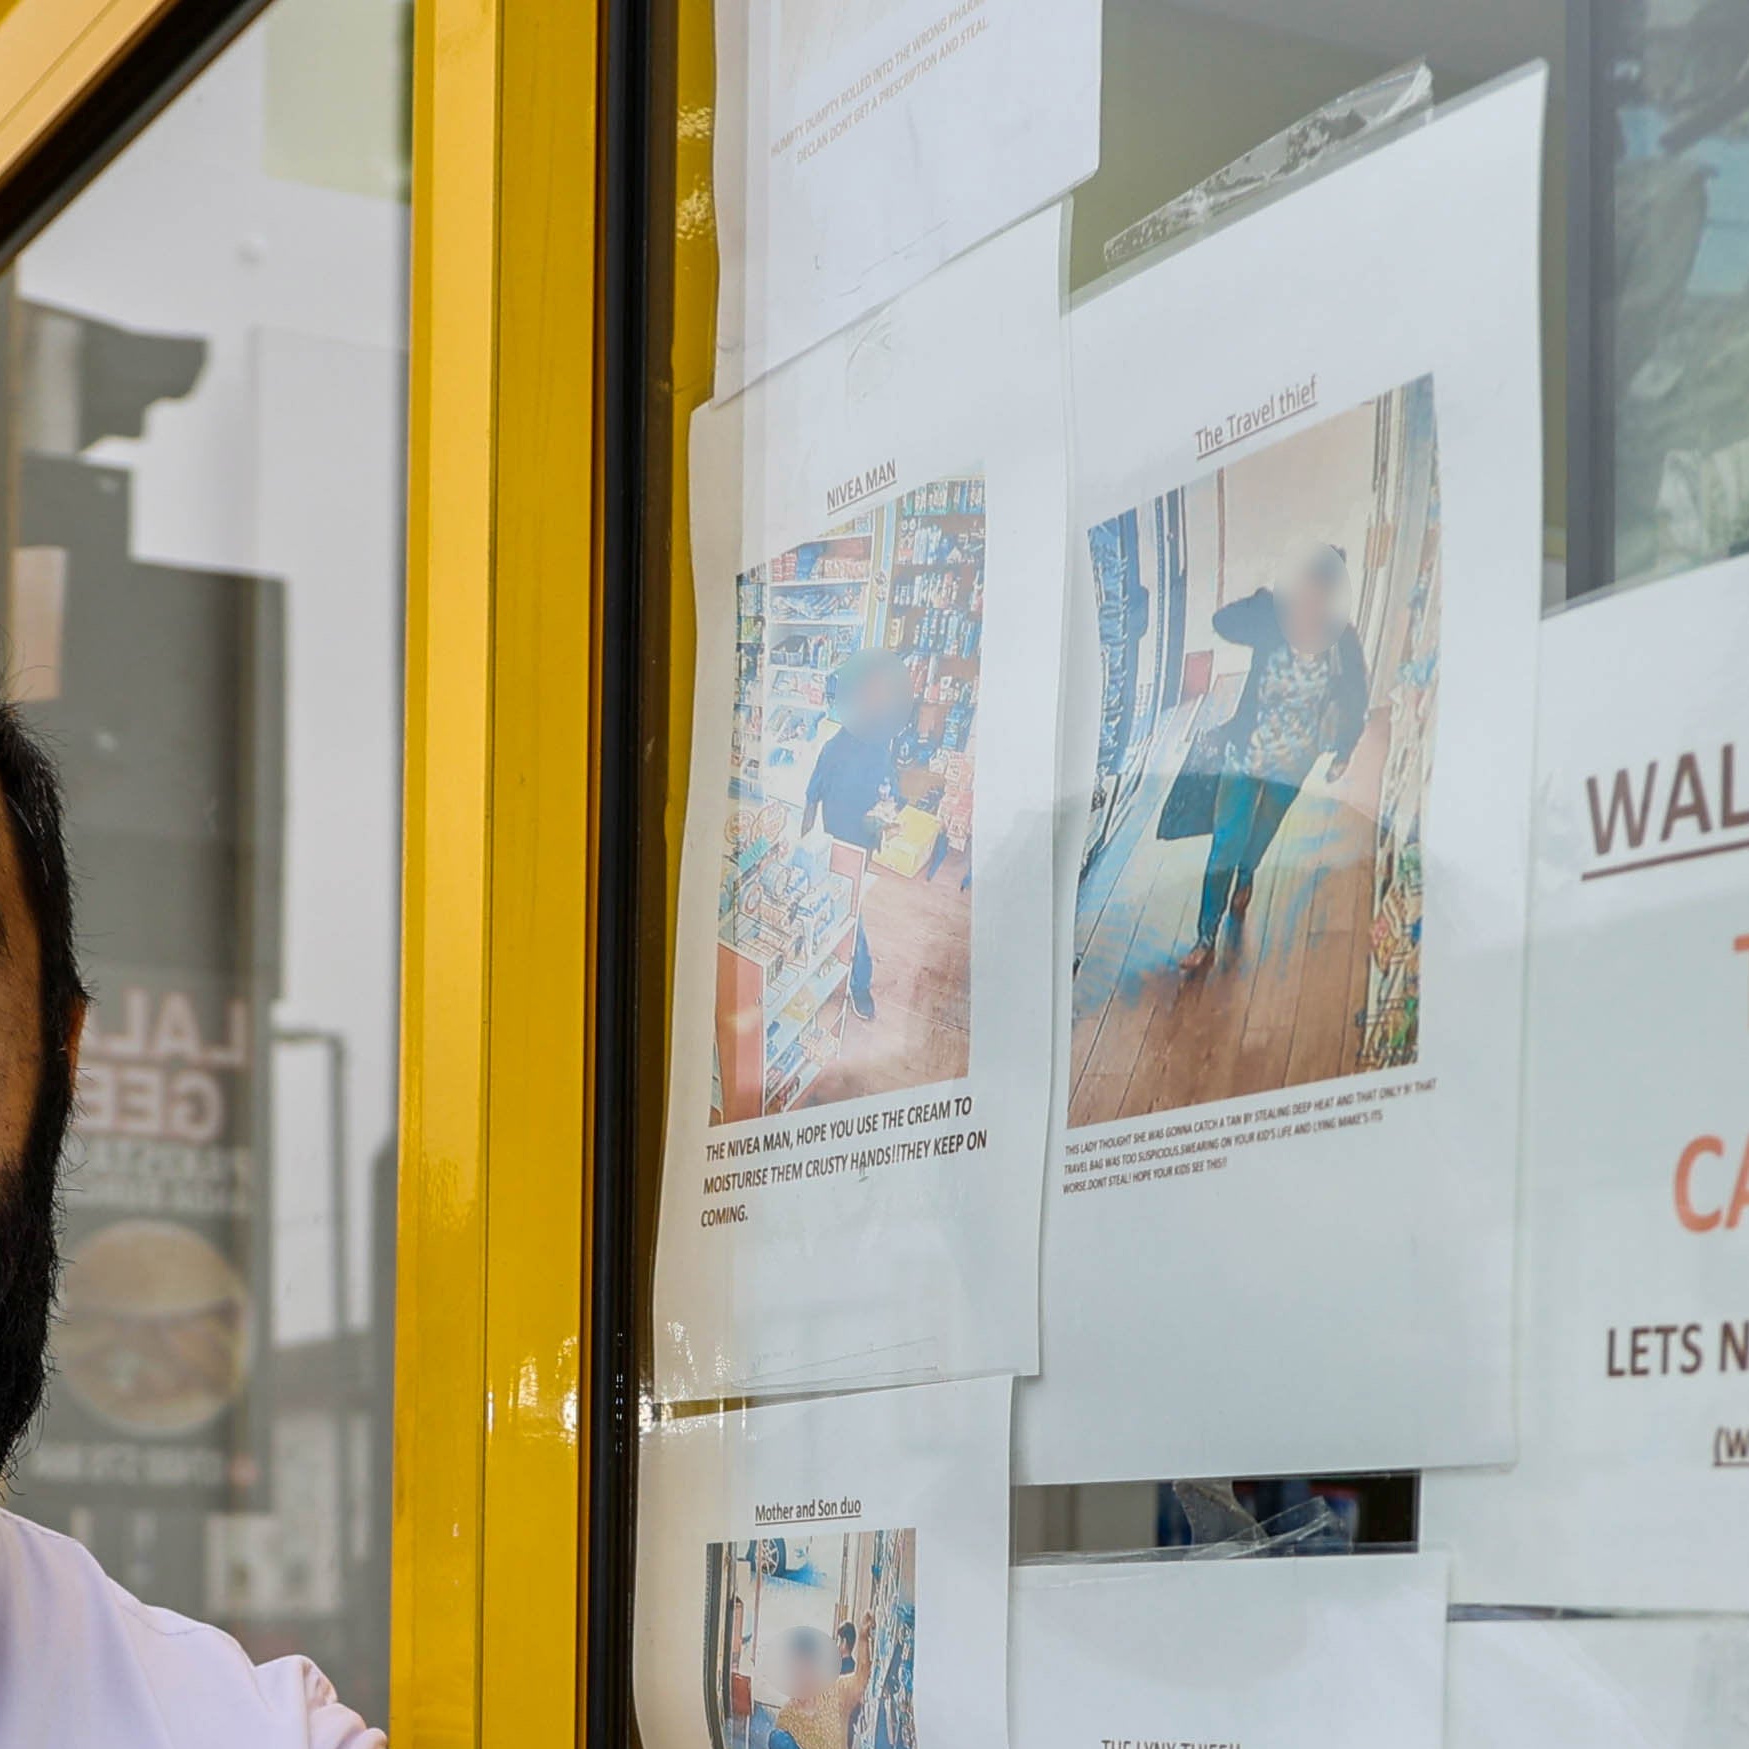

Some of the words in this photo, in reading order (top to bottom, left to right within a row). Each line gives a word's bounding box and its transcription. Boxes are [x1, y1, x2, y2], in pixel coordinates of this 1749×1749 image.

[1195, 425, 1223, 453] The
[1227, 394, 1275, 438] Travel
[1279, 372, 1317, 415] thief
[827, 475, 863, 511] NIVEA
[865, 457, 896, 492] MAN
[706, 1142, 724, 1162] THE
[727, 1136, 759, 1158] NIVEA
[763, 1129, 792, 1153] MAN,
[796, 1123, 825, 1145] HOPE
[830, 1118, 853, 1139] YOU
[857, 1113, 877, 1134] USE
[883, 1108, 903, 1129] THE
[907, 1100, 950, 1125] CREAM
[955, 1095, 972, 1116] TO
[1099, 1134, 1131, 1150] THOUGHT
[1133, 1131, 1145, 1143] SHE
[1219, 1117, 1223, 1128] A
[703, 1167, 767, 1194] MOISTURISE
[771, 1161, 802, 1183] THEM
[805, 1153, 847, 1177] CRUSTY
[933, 1133, 963, 1156] KEEP
[967, 1129, 986, 1150] ON
[701, 1204, 747, 1227] COMING.
[1607, 1323, 1703, 1377] LETS
[755, 1502, 793, 1522] Mother
[796, 1499, 815, 1518] and
[818, 1499, 837, 1517] Son
[840, 1496, 861, 1515] duo
